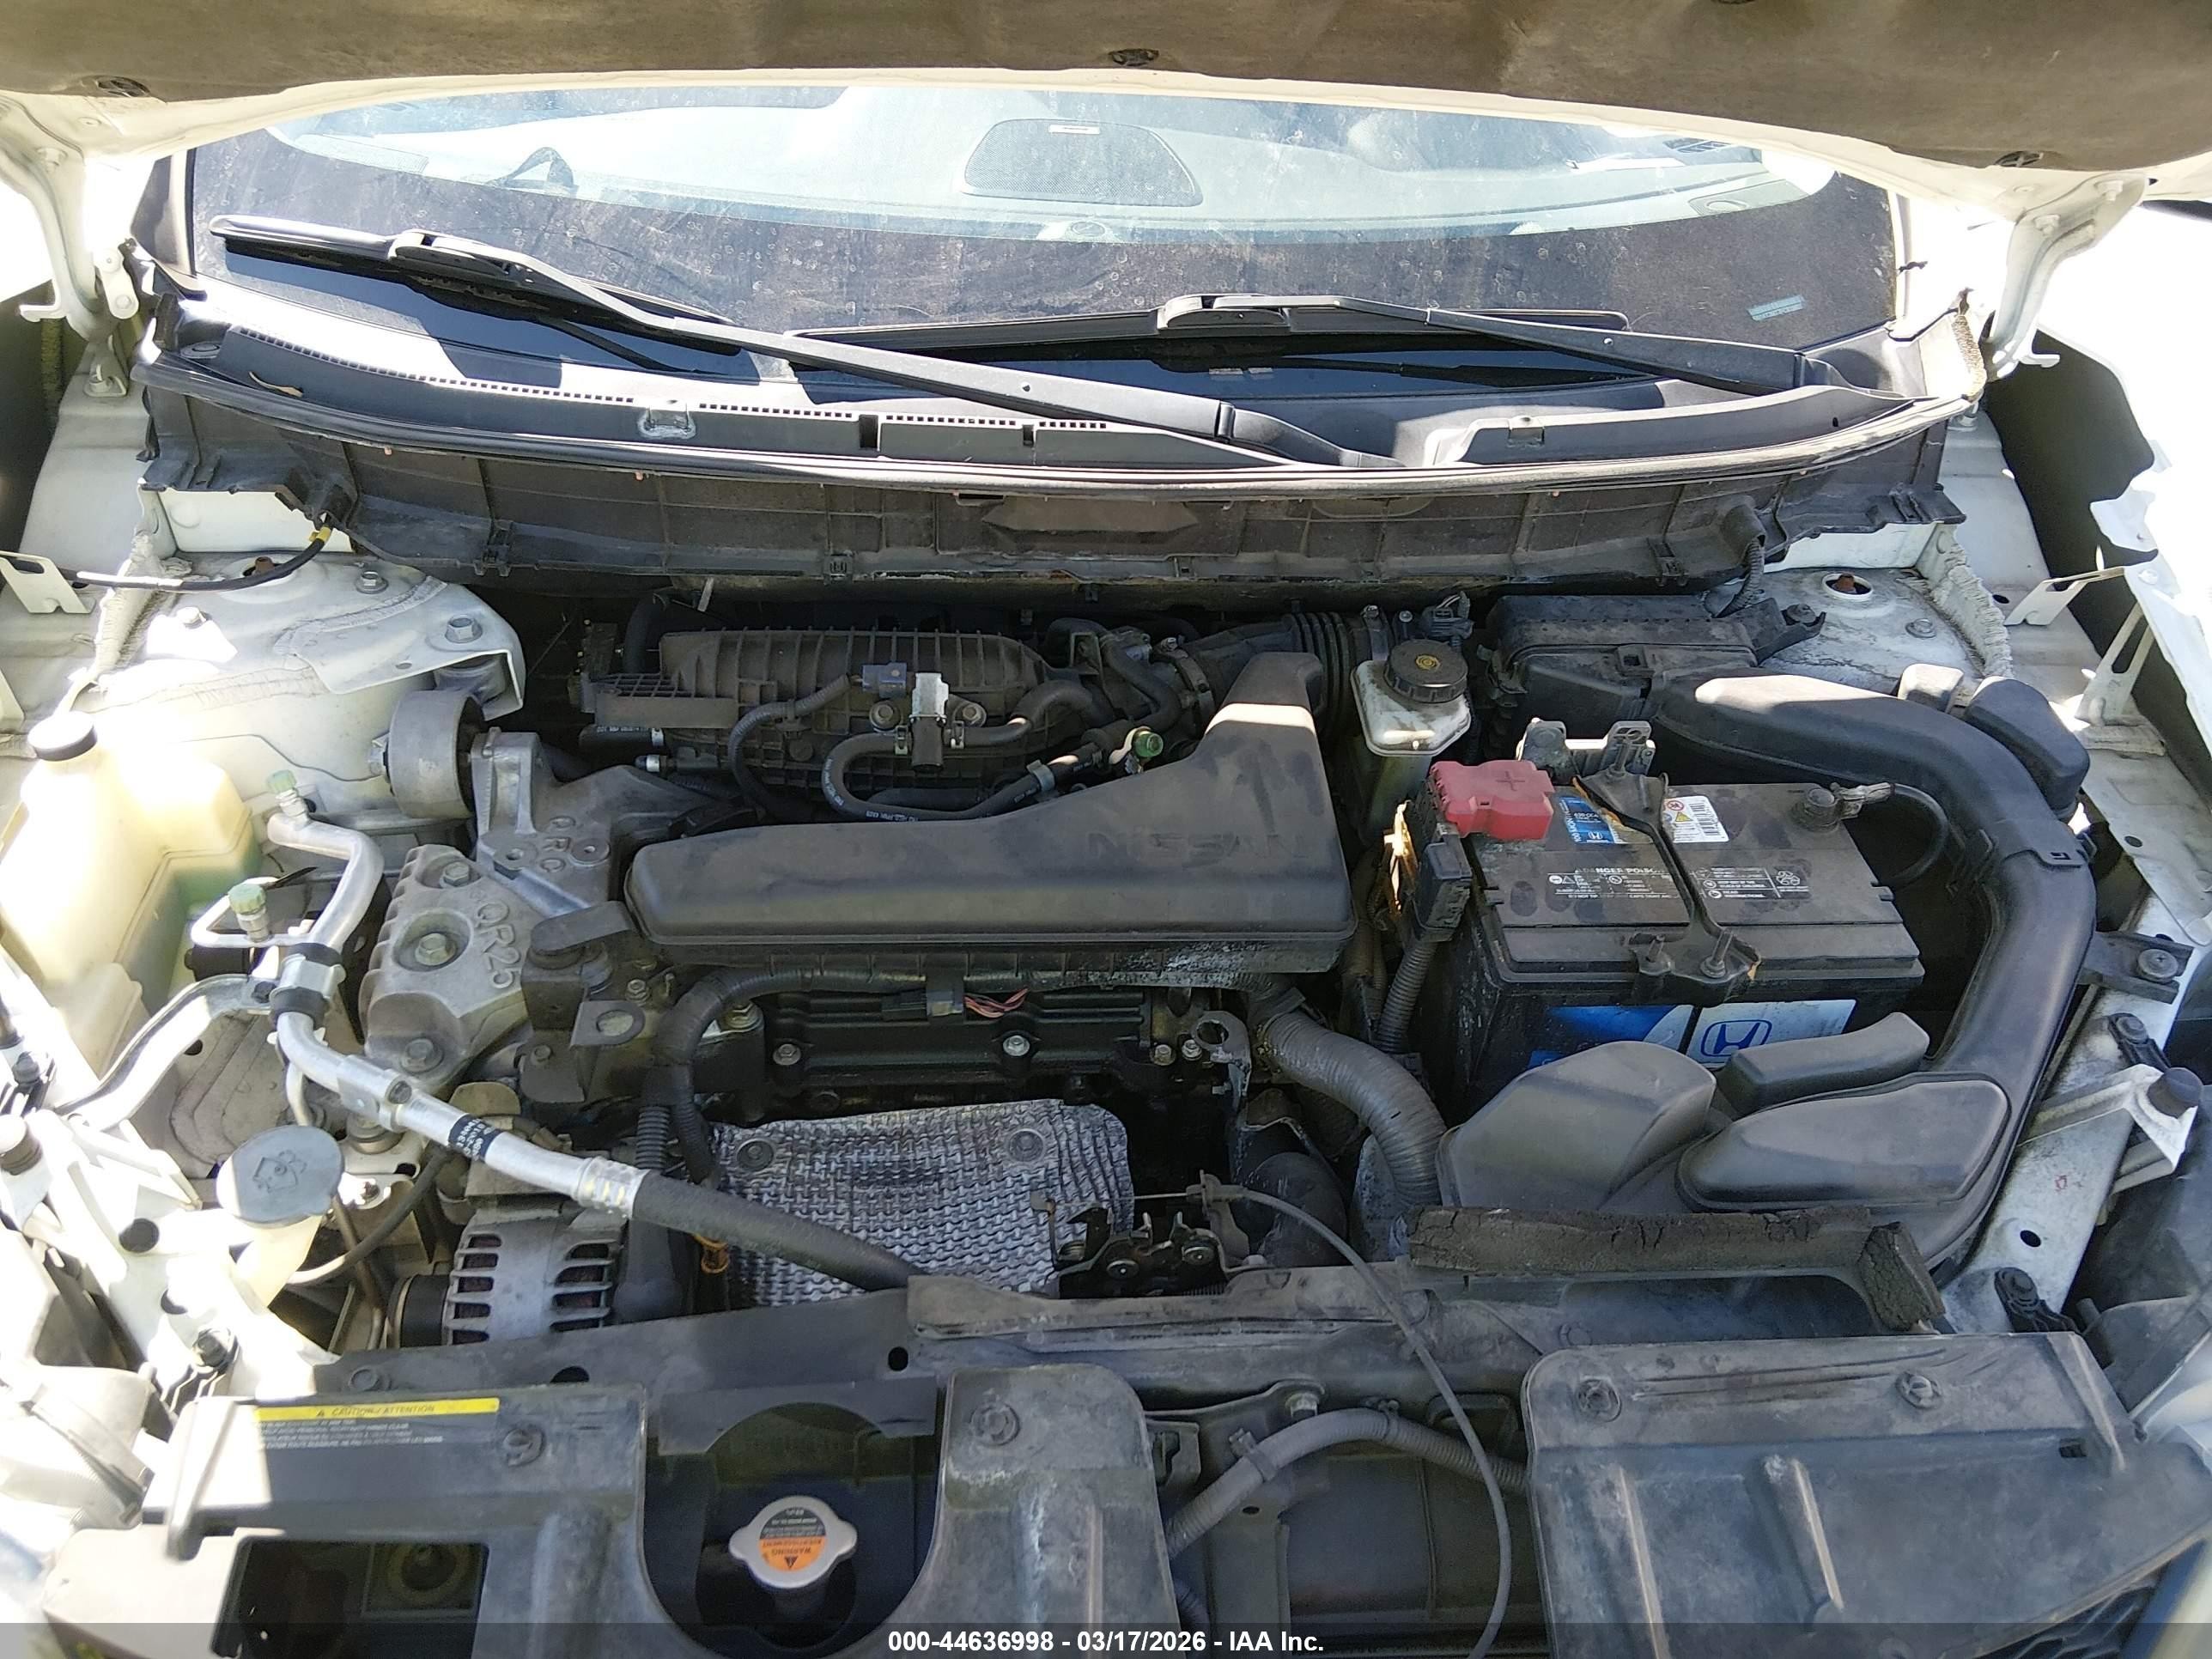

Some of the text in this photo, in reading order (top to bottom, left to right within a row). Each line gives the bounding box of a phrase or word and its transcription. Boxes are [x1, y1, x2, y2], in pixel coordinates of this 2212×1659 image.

[473, 901, 521, 989] QR25
[331, 1407, 376, 1417] CAUTION
[771, 1547, 811, 1556] WARNING
